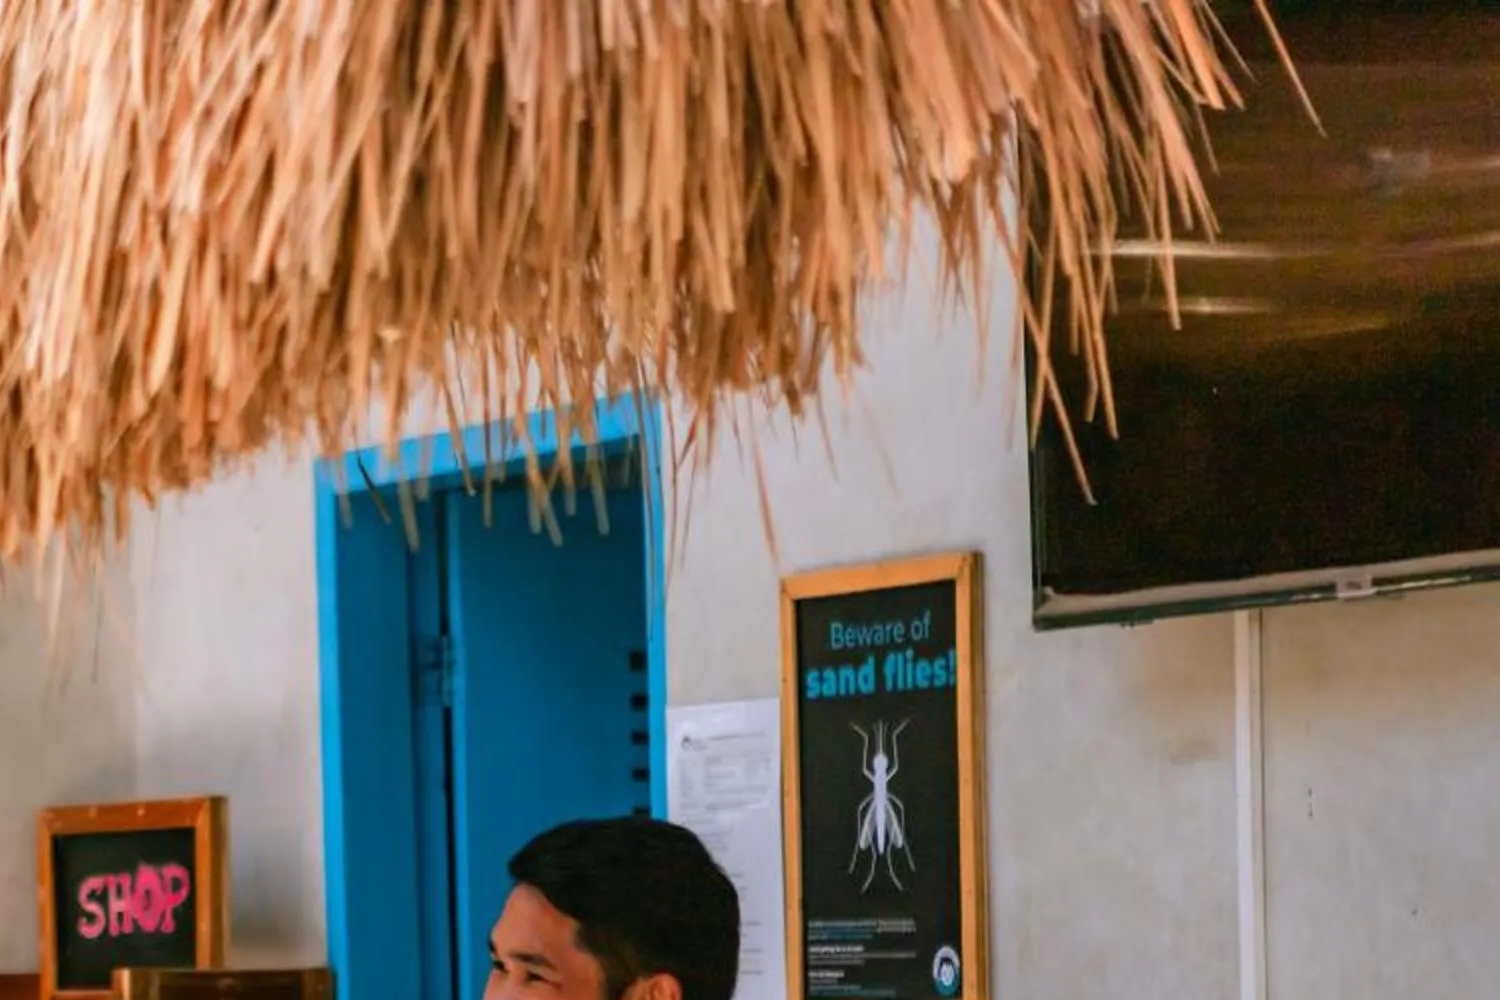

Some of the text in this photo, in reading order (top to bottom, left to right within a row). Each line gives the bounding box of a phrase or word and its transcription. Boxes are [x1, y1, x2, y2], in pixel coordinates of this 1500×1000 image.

[830, 610, 931, 650] Beware of
[806, 647, 956, 698] sand flies!
[78, 863, 190, 939] SHOP
